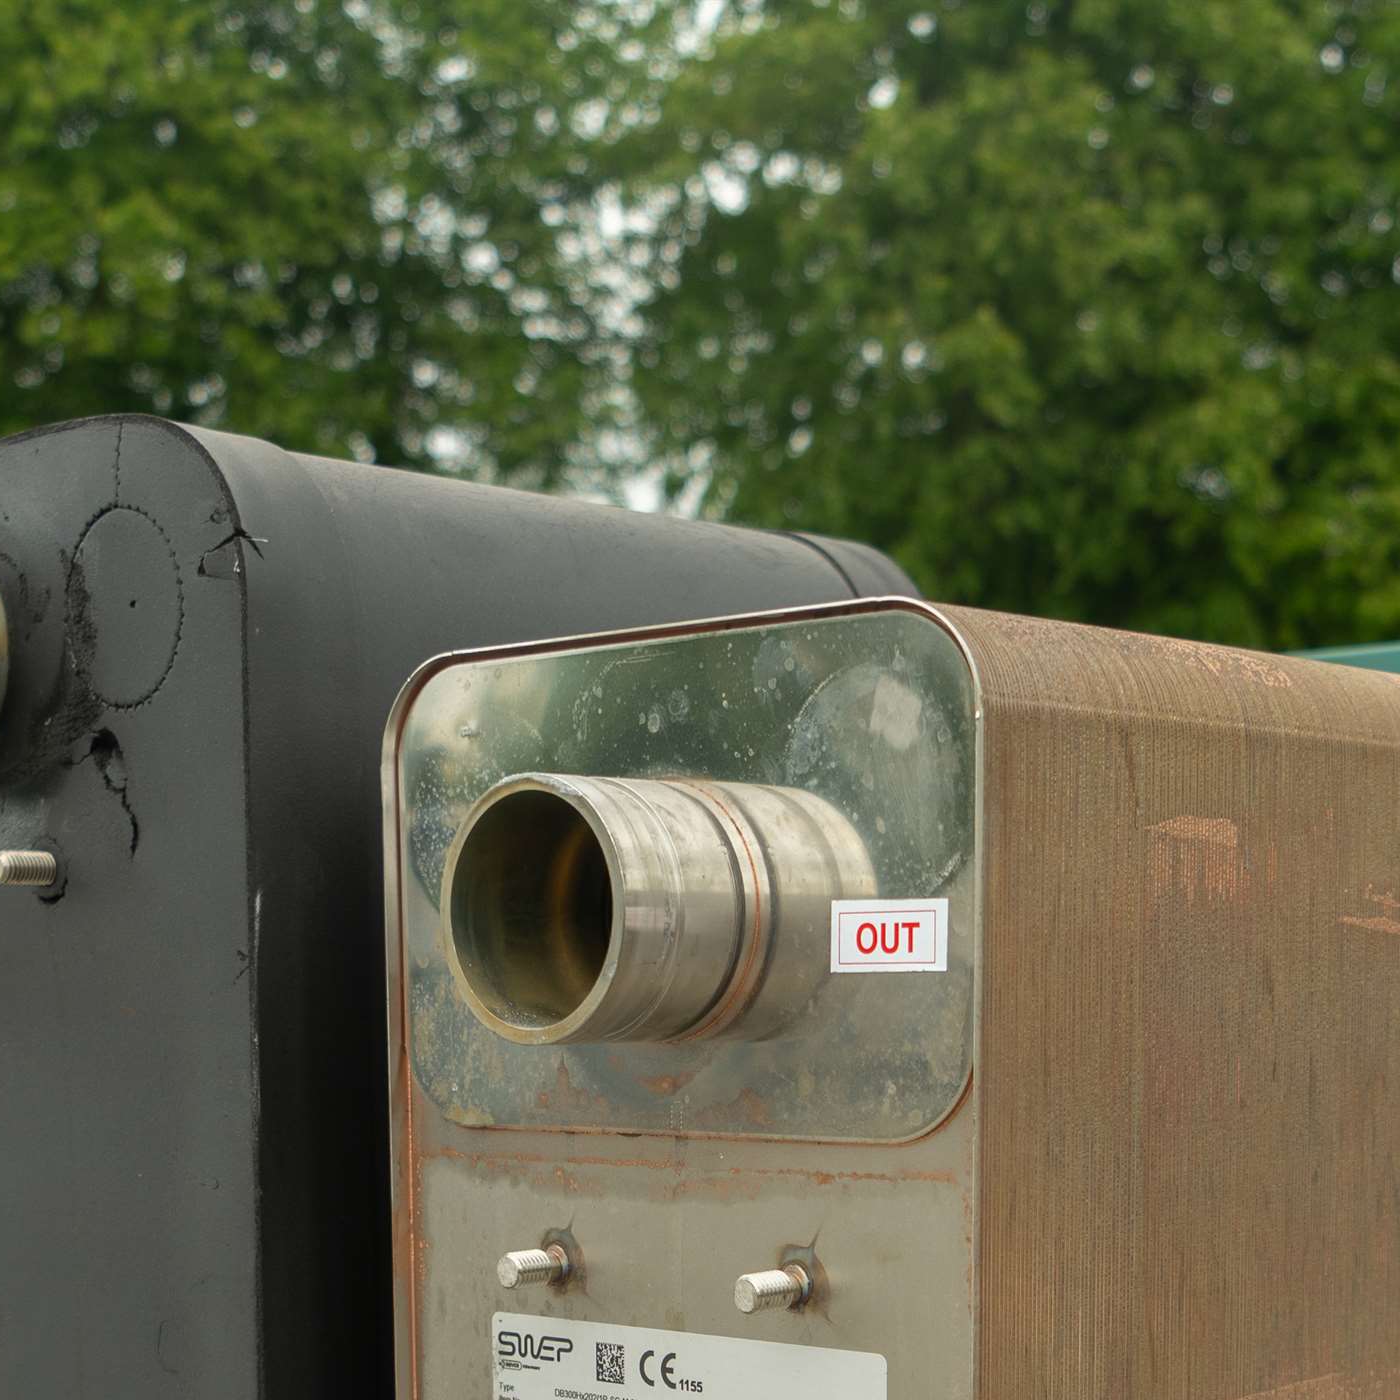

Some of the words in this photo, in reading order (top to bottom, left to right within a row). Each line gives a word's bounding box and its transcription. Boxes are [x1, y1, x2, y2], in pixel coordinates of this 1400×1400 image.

[498, 331, 573, 362] SWEP
[856, 922, 920, 954] OUT
[499, 1382, 515, 1392] Type
[678, 1379, 703, 1393] 1155
